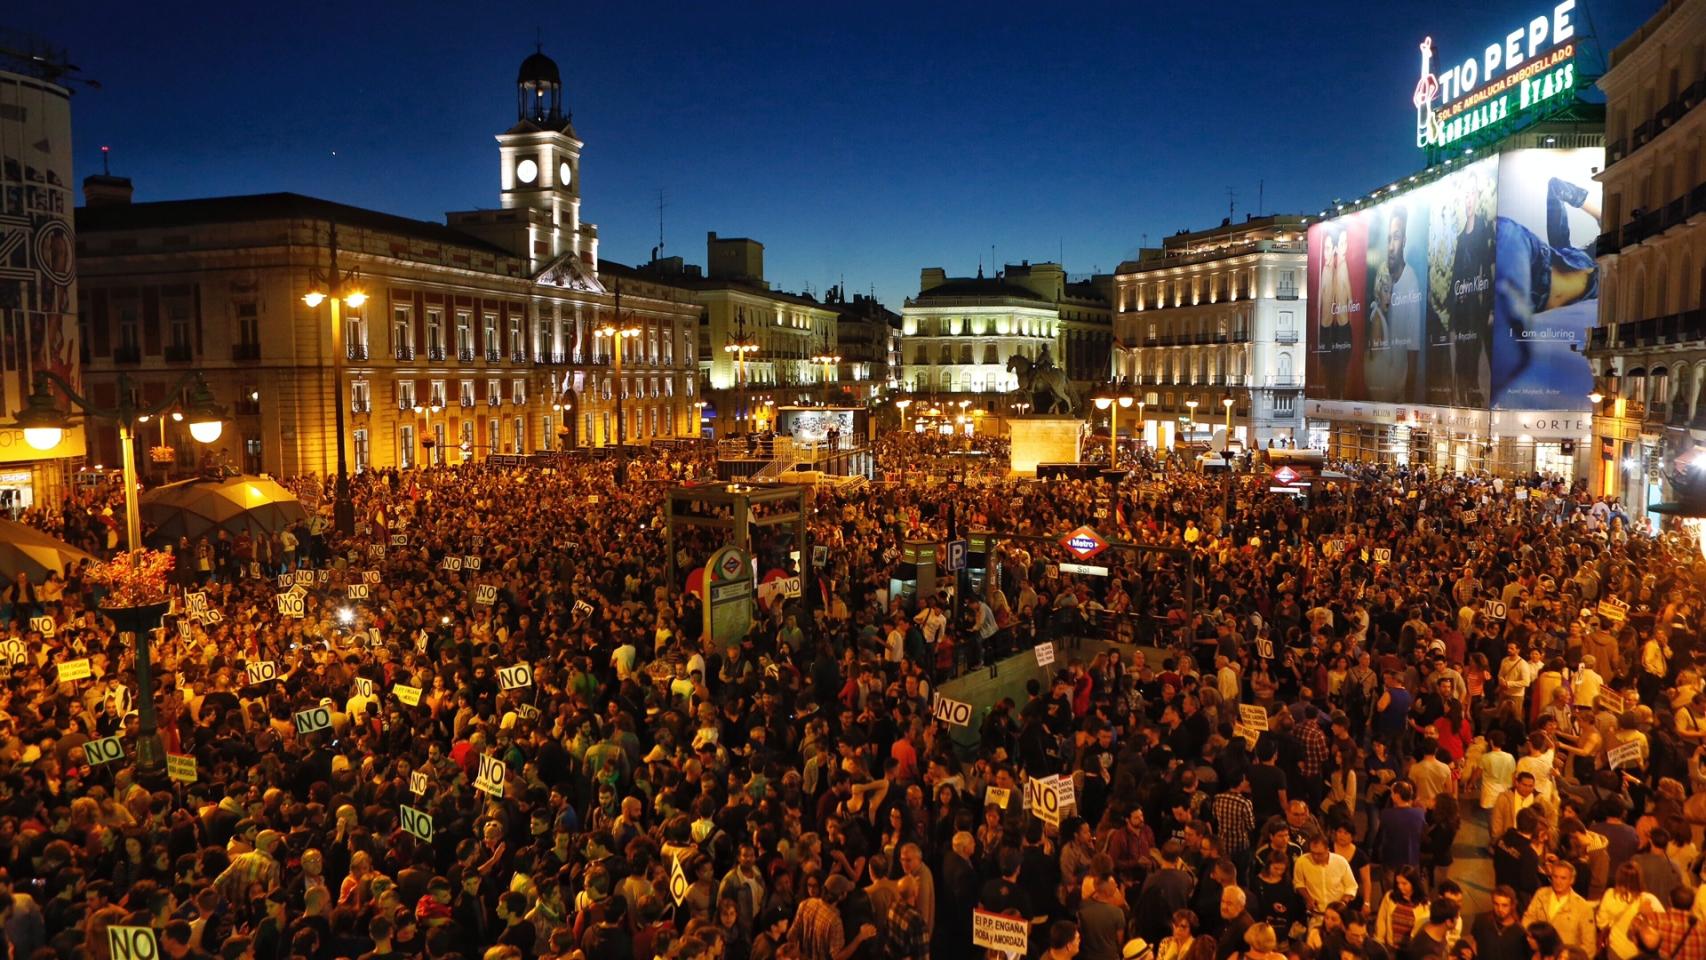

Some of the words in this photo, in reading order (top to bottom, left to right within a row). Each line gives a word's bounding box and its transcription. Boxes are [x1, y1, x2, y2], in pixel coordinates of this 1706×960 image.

[1438, 57, 1477, 104] TIO
[1484, 0, 1576, 81] PEPE
[1438, 107, 1452, 122] SOL
[1452, 101, 1463, 114] DE
[1463, 80, 1505, 109] ANDALUCIA
[1454, 279, 1473, 295] Calvin
[1473, 275, 1489, 293] Klein
[1521, 329, 1537, 338] am
[1540, 328, 1575, 341] alluring
[1524, 419, 1592, 430] ORTE
[1464, 510, 1476, 519] NO
[370, 545, 384, 555] NO
[1072, 538, 1094, 549] Metro
[1332, 540, 1345, 551] NO
[953, 544, 963, 570] P
[1375, 549, 1390, 560] NO
[443, 558, 460, 570] NO
[466, 557, 480, 568] NO
[297, 571, 313, 582] NO
[363, 571, 379, 581] NO
[1077, 566, 1090, 574] Sol
[279, 574, 293, 585] NO
[785, 579, 800, 593] NO
[349, 585, 368, 597] NO
[478, 586, 495, 599] NO
[284, 599, 303, 612] NO
[1486, 602, 1505, 617] NO
[32, 618, 53, 630] NO
[1257, 639, 1273, 657] NO
[248, 664, 275, 682] NO
[499, 667, 529, 688] NO
[357, 679, 371, 698] NO
[521, 706, 539, 720] NO
[938, 699, 969, 723] NO
[297, 709, 329, 732] NO
[85, 738, 122, 764] NO
[480, 753, 504, 785] NO
[411, 773, 426, 793] NO
[1030, 779, 1058, 813] NO
[402, 807, 431, 839] NO
[975, 928, 989, 942] ROBA
[110, 928, 155, 960] NO
